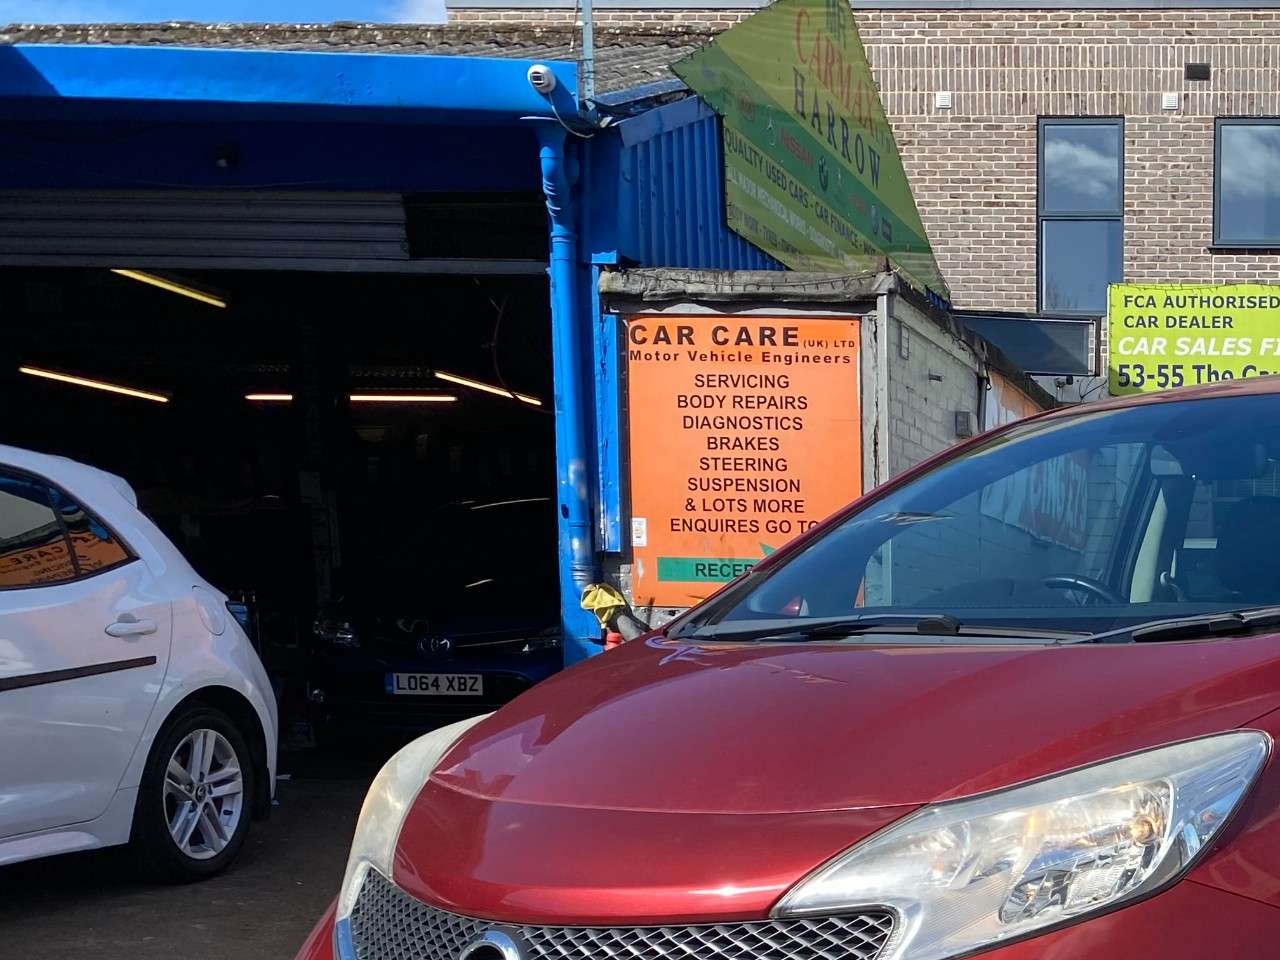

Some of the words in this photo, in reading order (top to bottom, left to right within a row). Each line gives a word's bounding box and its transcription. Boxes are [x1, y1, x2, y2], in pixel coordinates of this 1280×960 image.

[793, 66, 881, 190] HARROW
[724, 127, 764, 173] QUALITY
[765, 158, 788, 192] USED
[788, 179, 809, 210] CARS
[1123, 295, 1158, 309] FCA
[1123, 314, 1161, 329] CAR
[1164, 314, 1235, 330] DEALER
[629, 324, 695, 346] CAR
[711, 325, 800, 347] CARE
[803, 339, 829, 349] (UK)
[833, 339, 855, 348] LTD
[1117, 336, 1167, 357] CAR
[1173, 336, 1254, 358] SALES
[629, 350, 680, 362] Motor
[688, 350, 753, 363] Vehicle
[761, 351, 851, 366] Engineers
[694, 373, 790, 389] SERVICING
[1117, 363, 1185, 389] 53-55
[677, 394, 727, 409] BODY
[732, 395, 809, 410] REPAIRS
[682, 415, 804, 431] DIAGNOSTICS
[706, 435, 780, 451] BRAKES
[699, 456, 788, 472] STEERING
[687, 477, 801, 493] SUSPENSION
[684, 497, 697, 512] &
[702, 498, 748, 513] LOTS
[753, 499, 805, 514] MORE
[670, 518, 760, 534] ENQUIRES
[765, 519, 792, 535] GO
[695, 562, 754, 578] RECEP
[446, 675, 480, 692] XBZ
